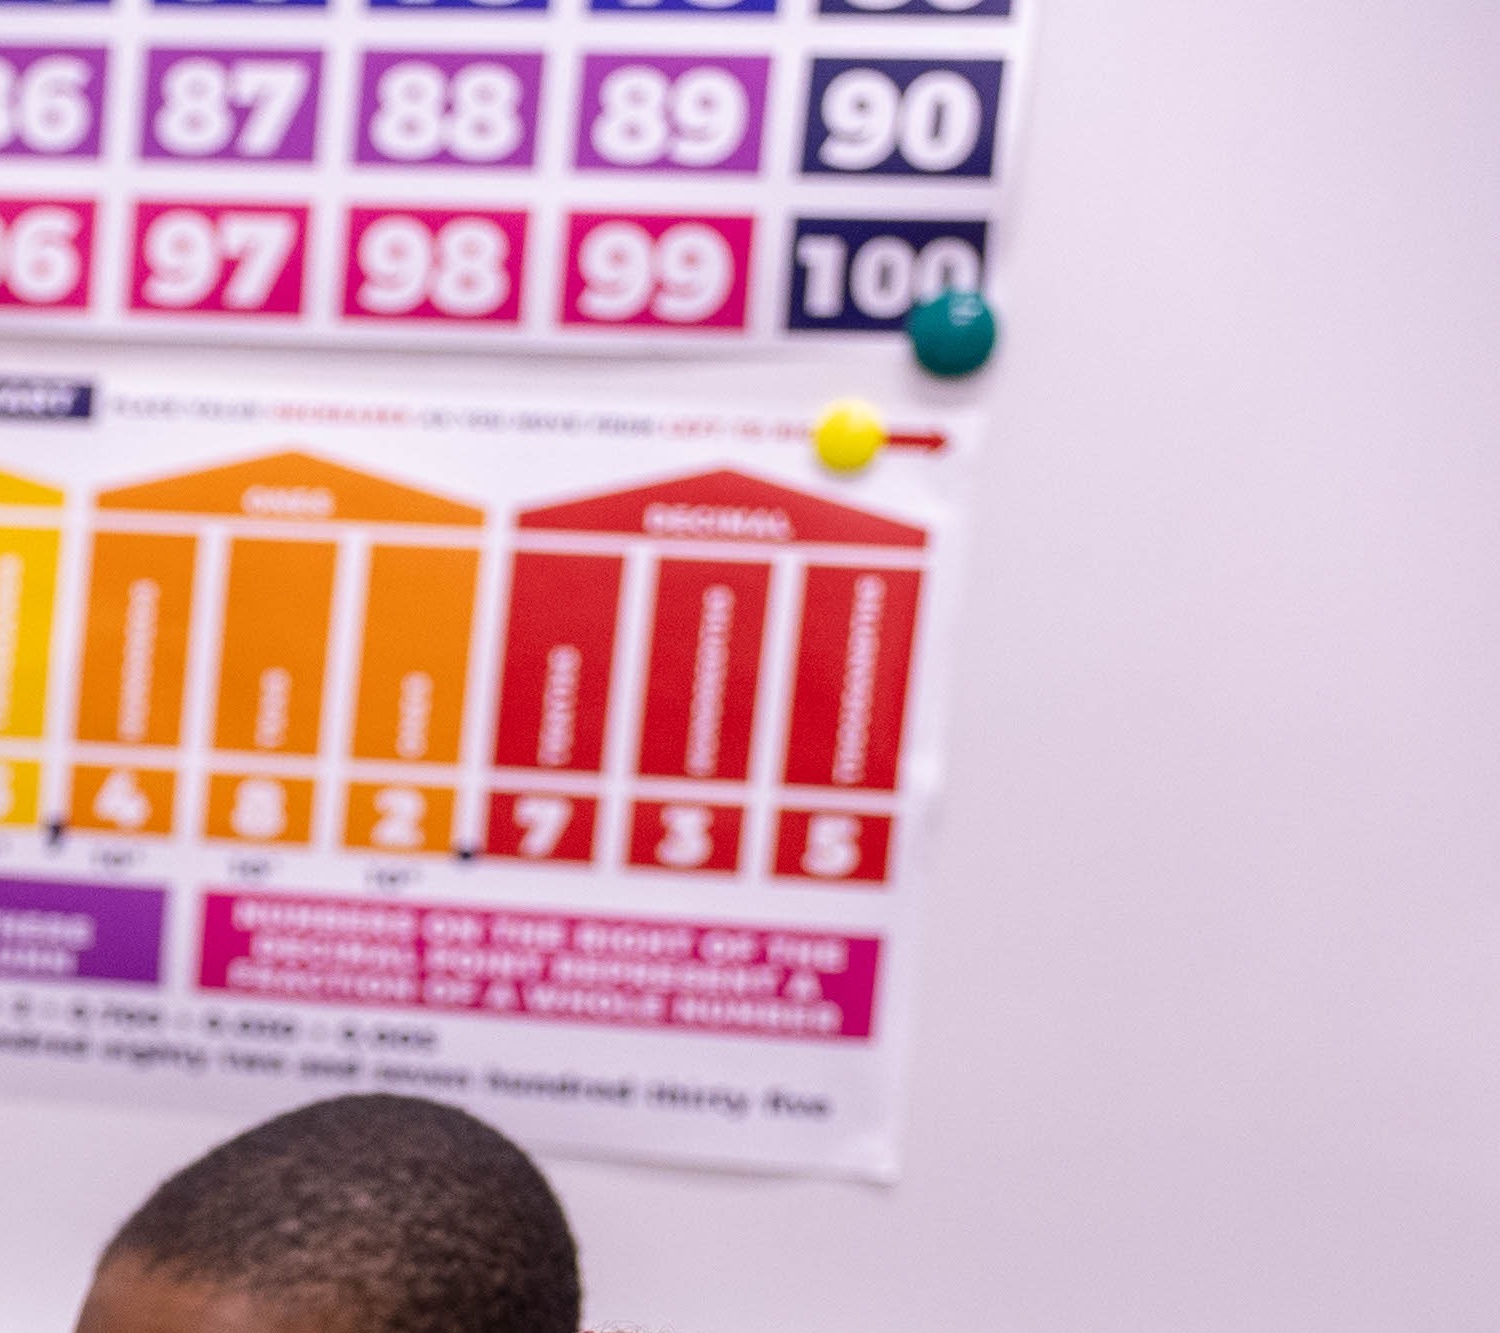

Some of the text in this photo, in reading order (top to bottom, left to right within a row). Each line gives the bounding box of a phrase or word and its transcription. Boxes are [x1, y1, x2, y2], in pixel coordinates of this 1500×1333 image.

[156, 56, 306, 157] 87
[370, 61, 523, 161] 88
[590, 64, 747, 165] 89
[820, 68, 981, 171] 90
[141, 208, 302, 307] 97
[356, 216, 511, 314] 98
[578, 220, 734, 322] 99
[796, 234, 981, 317] 100
[645, 502, 794, 540] DECIMAL
[95, 770, 149, 827] 4
[371, 786, 424, 848] 2
[513, 797, 572, 857] 7
[656, 802, 712, 868] 3
[803, 814, 861, 877] 5
